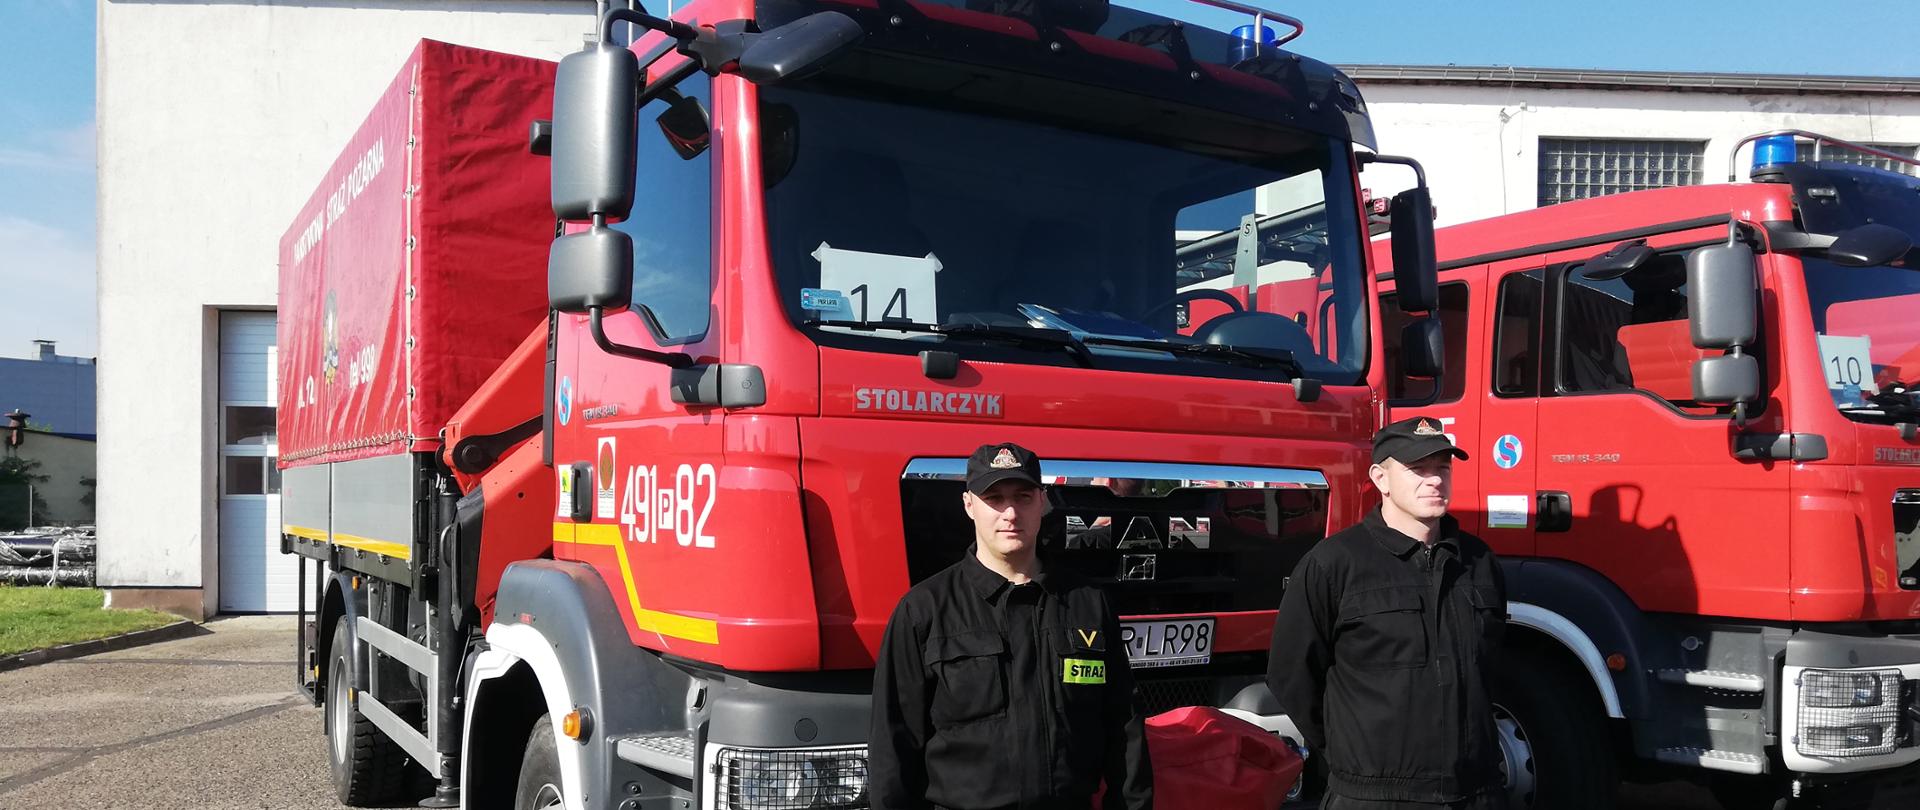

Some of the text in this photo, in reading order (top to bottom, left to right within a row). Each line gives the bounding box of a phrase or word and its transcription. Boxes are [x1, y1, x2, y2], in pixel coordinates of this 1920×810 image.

[850, 284, 912, 323] 14
[1831, 356, 1861, 385] 10
[856, 387, 1001, 416] STOLARCZYK
[1065, 516, 1211, 549] MAN
